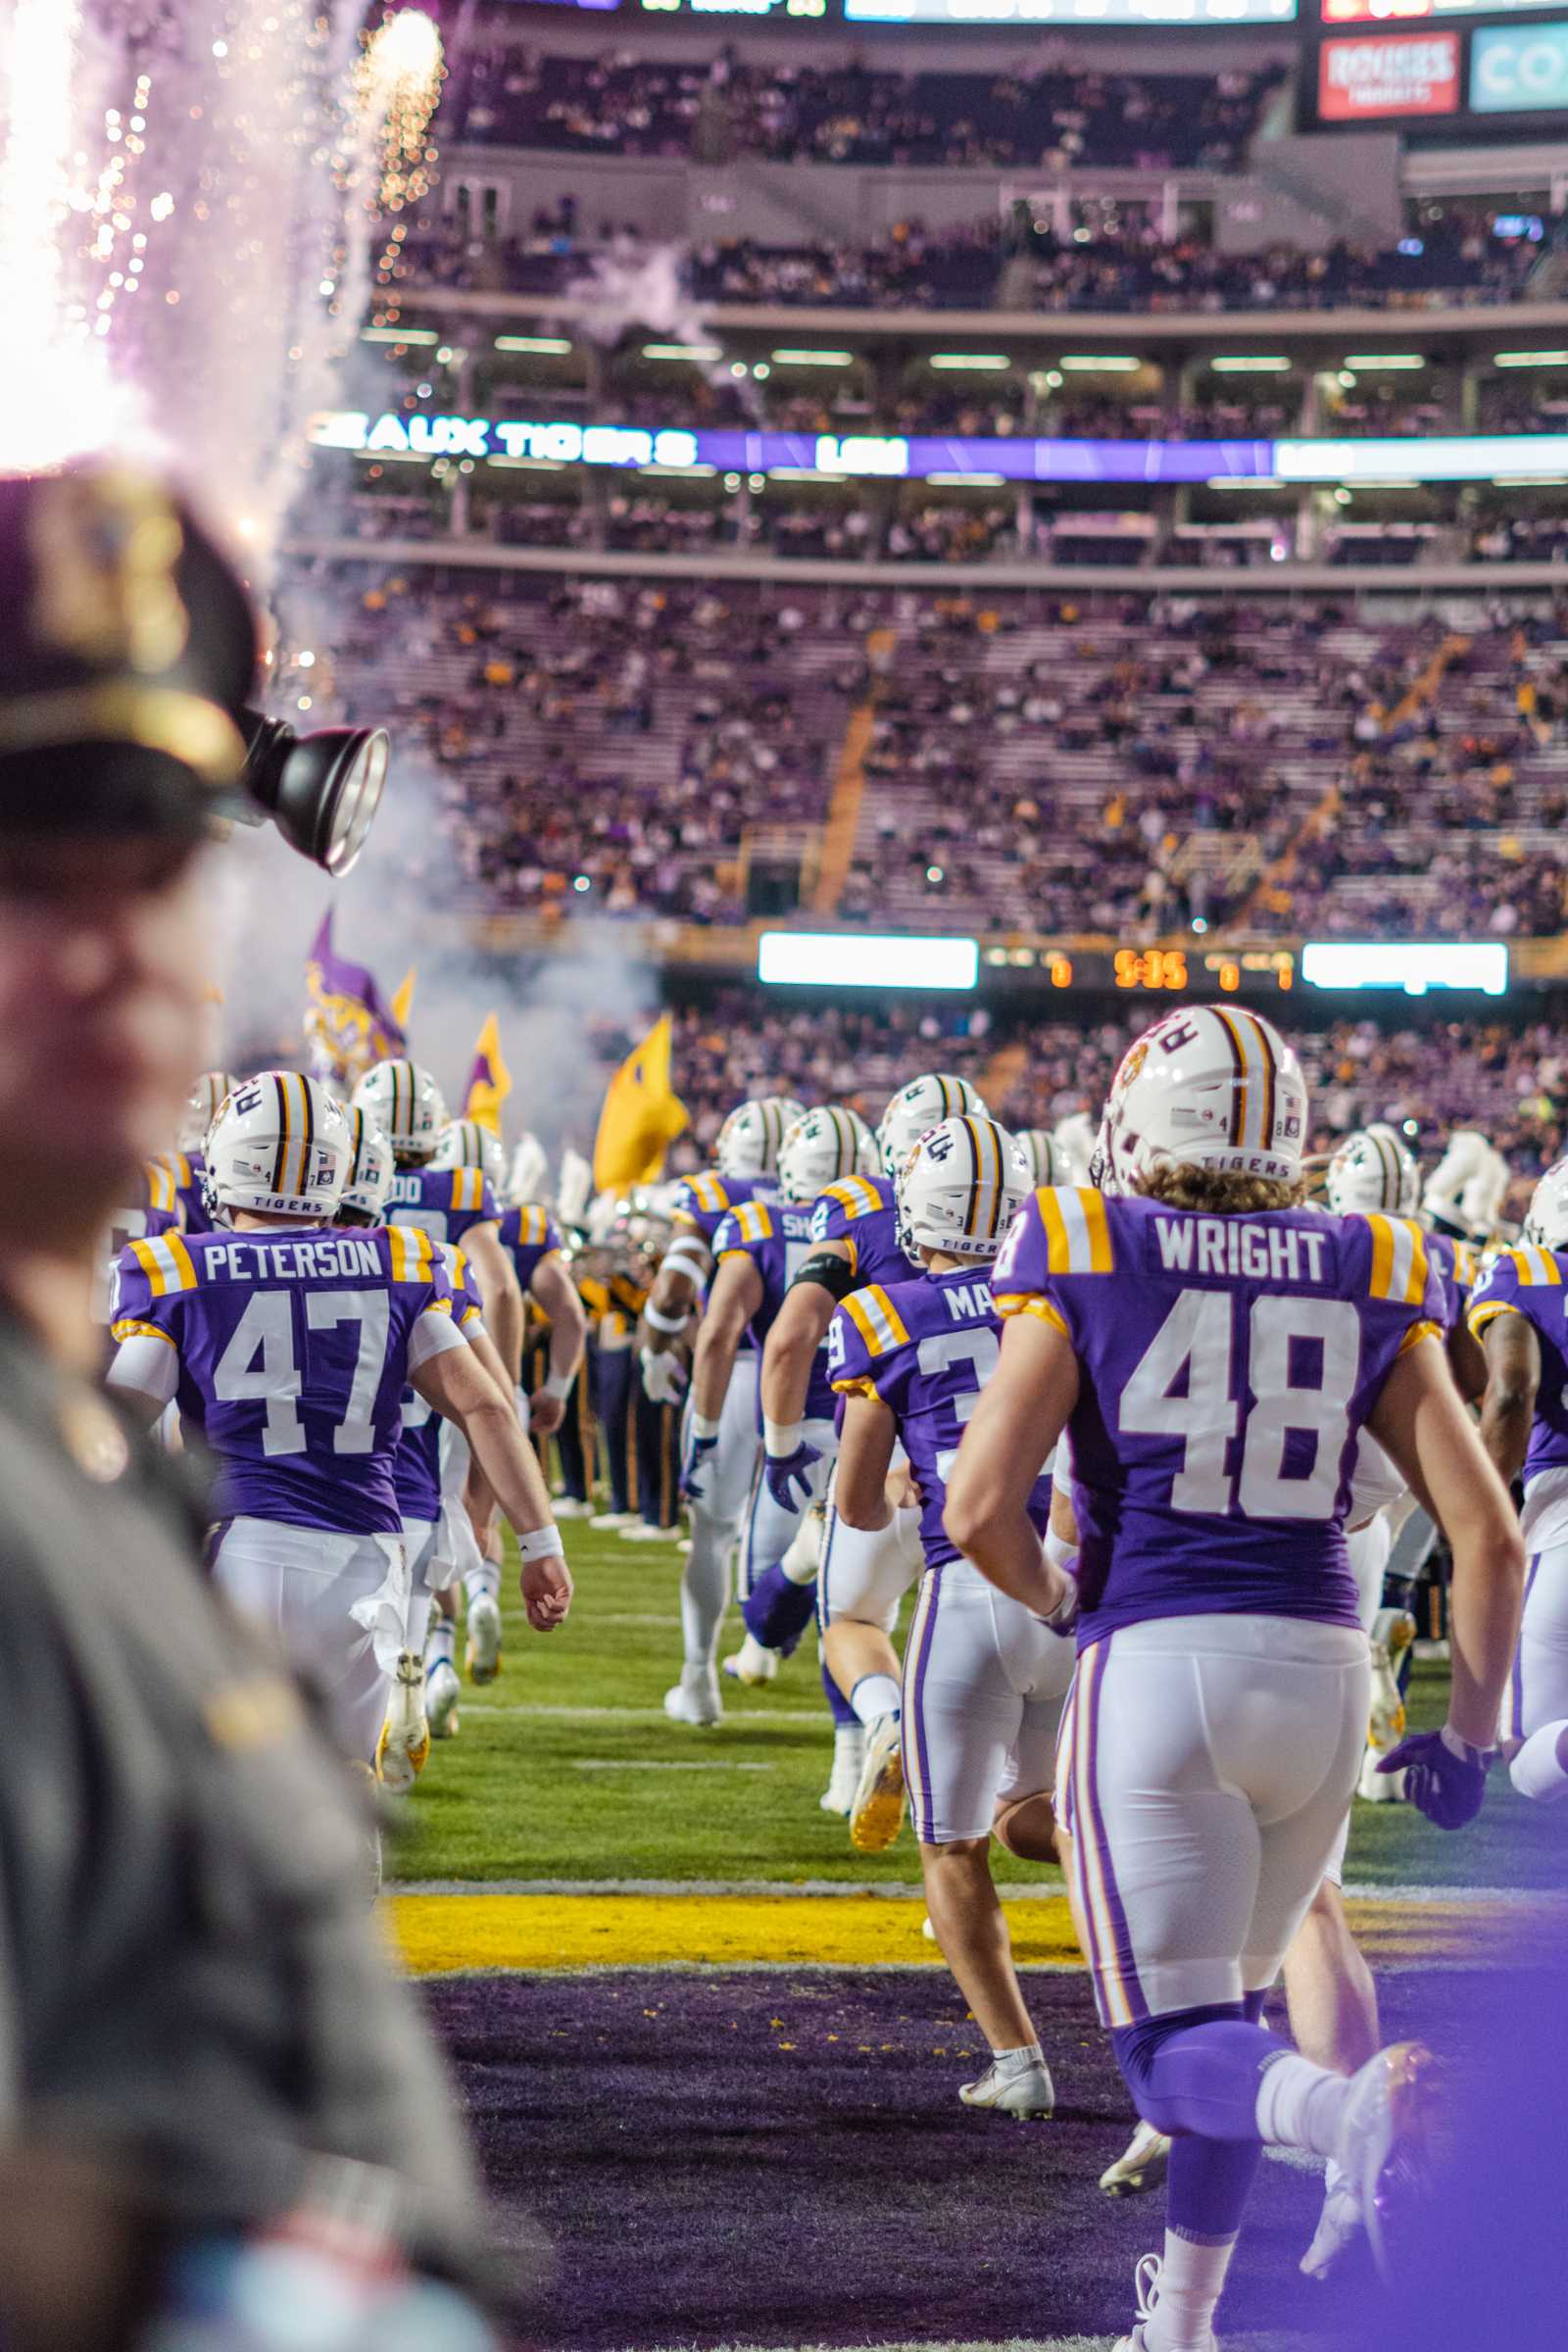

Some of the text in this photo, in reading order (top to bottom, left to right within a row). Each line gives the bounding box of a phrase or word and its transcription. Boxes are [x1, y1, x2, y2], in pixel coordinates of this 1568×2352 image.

[1200, 1155, 1290, 1178] TIGERS
[254, 1197, 323, 1212] TIGERS
[204, 1240, 383, 1280] PETERSON
[942, 1239, 997, 1252] TIGER
[1154, 1216, 1325, 1281] WRIGHT
[943, 1283, 993, 1321] MA
[213, 1289, 391, 1457] 47
[916, 1326, 1000, 1485] 3
[1118, 1288, 1361, 1520] 48
